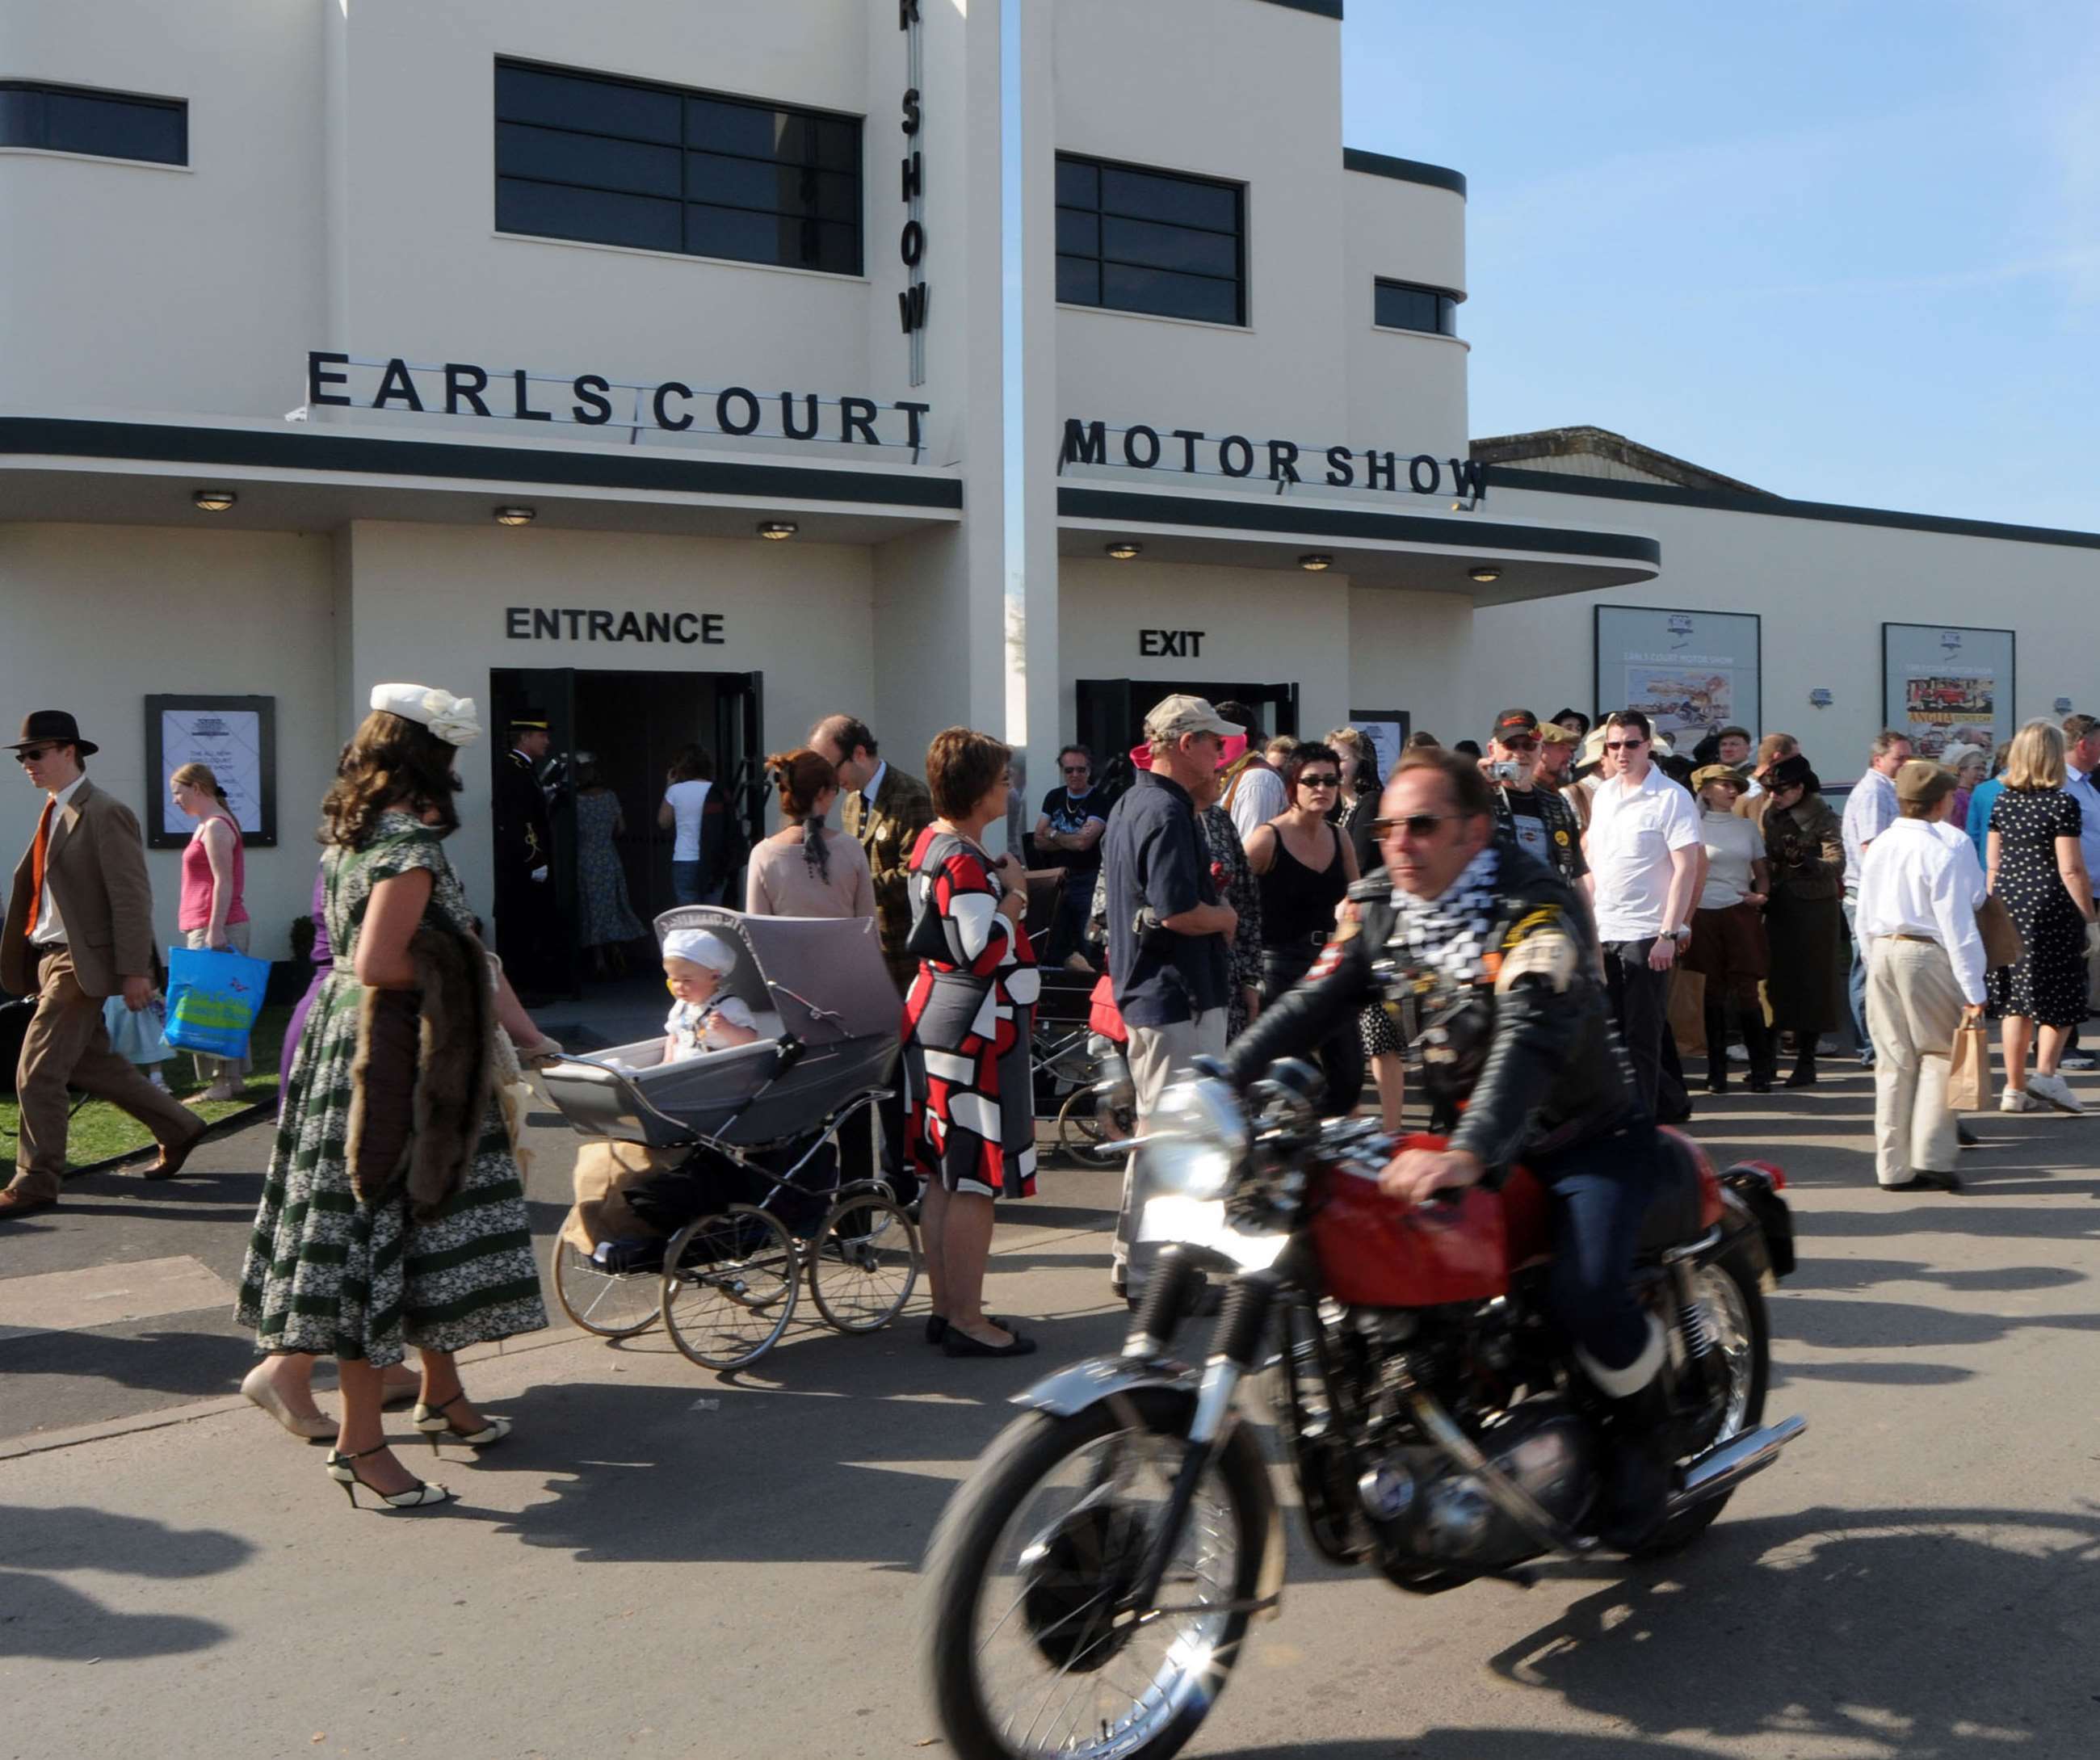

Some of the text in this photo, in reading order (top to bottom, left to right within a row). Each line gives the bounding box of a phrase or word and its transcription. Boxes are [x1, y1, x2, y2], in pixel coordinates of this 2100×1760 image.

[899, 88, 926, 334] SHOW
[309, 351, 930, 448] EARLS COURT
[1065, 418, 1487, 500] MOTOR SHOW
[505, 607, 725, 645] ENTRANCE
[1139, 629, 1206, 657] EXIT
